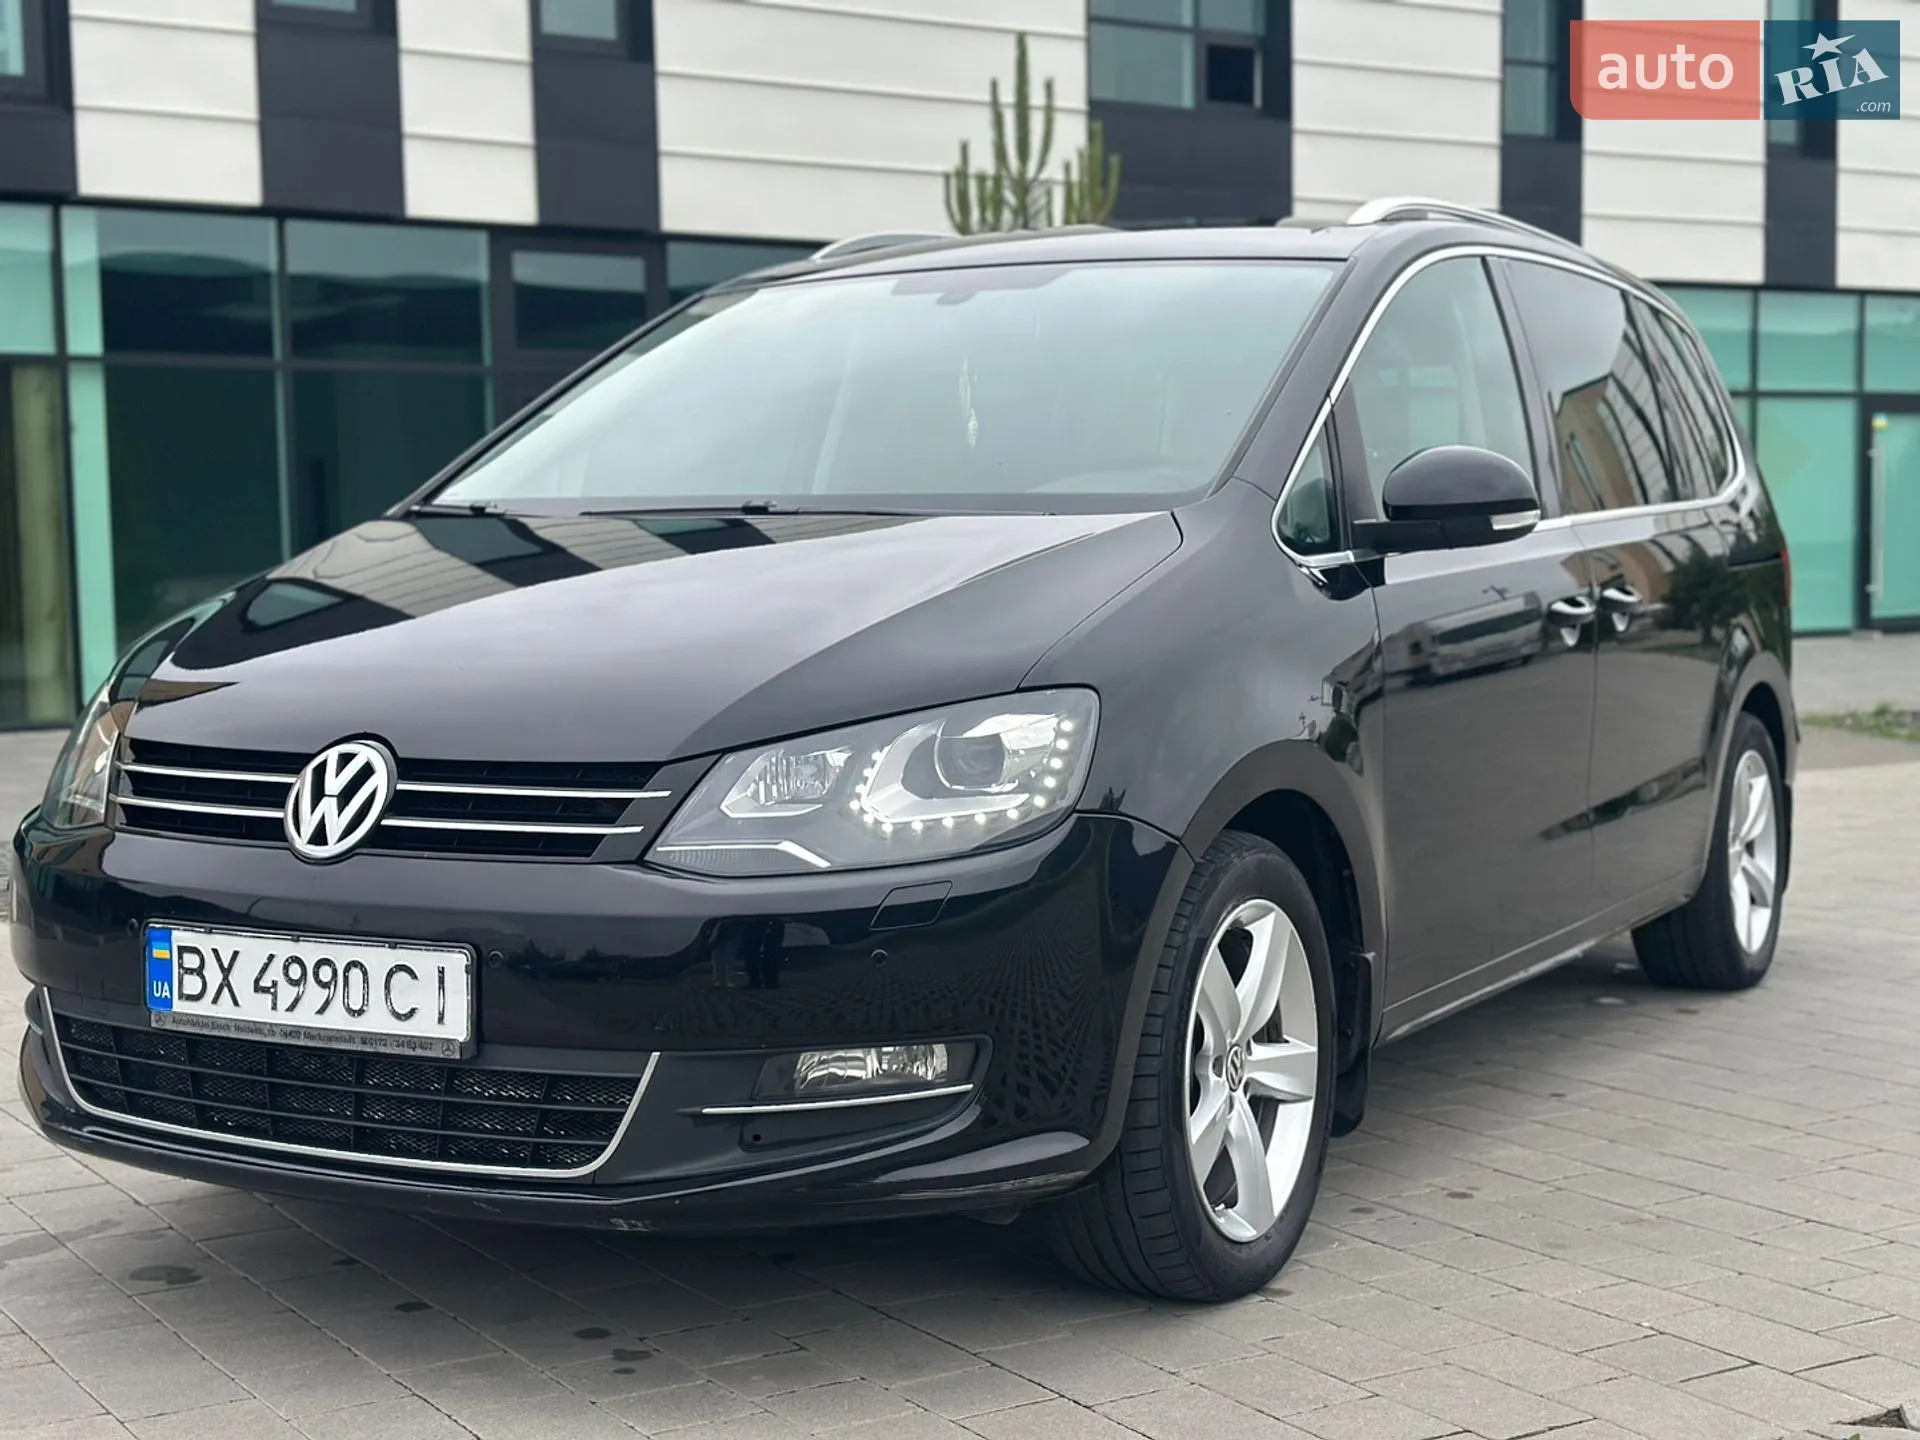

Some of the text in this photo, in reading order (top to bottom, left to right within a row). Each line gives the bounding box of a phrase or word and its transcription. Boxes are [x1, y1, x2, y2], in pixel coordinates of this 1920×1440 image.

[153, 981, 172, 999] UA
[176, 945, 241, 1007] BX
[253, 952, 370, 1018] 4990
